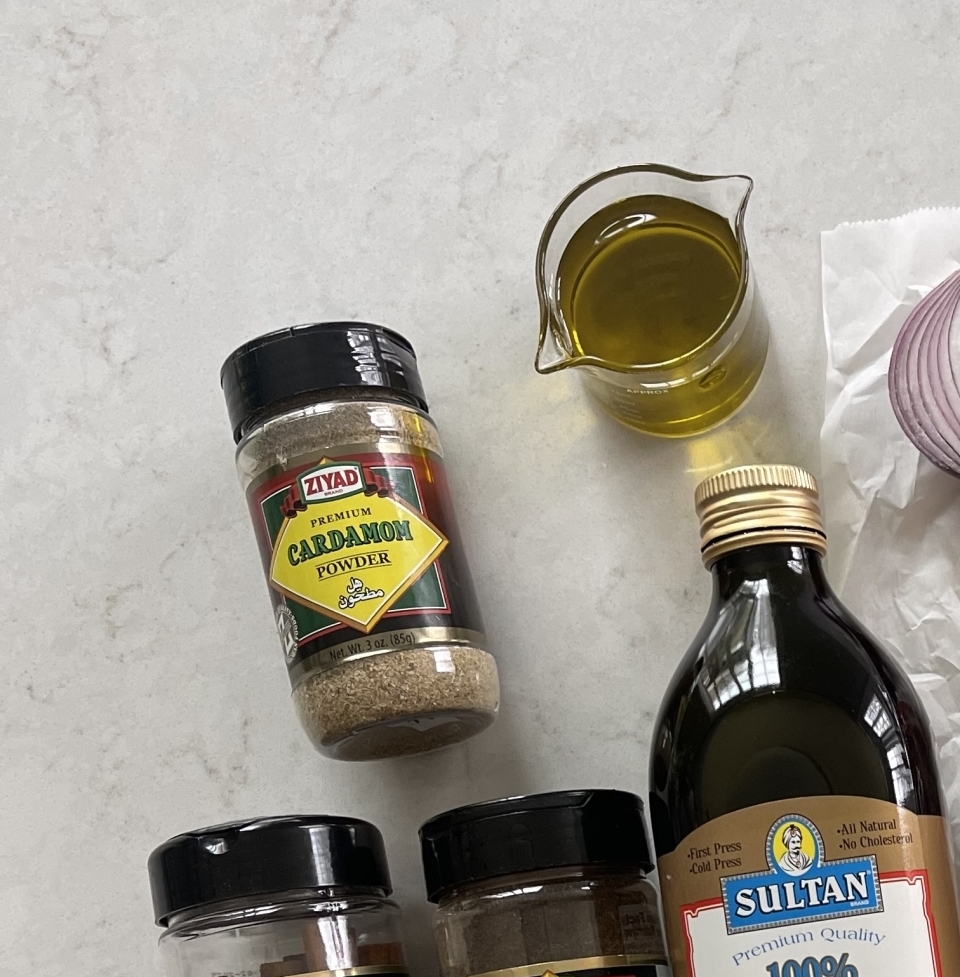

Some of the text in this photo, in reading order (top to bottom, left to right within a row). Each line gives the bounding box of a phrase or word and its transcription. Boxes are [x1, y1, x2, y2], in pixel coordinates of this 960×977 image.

[304, 469, 359, 496] ZIYAD
[310, 507, 372, 528] PREMIUM
[288, 520, 414, 566] CARDAMOM
[316, 552, 391, 578] POWDER
[338, 588, 385, 609] مطحون
[368, 640, 372, 650] 3
[375, 638, 388, 648] oz.
[390, 632, 416, 648] (85g)
[841, 819, 897, 836] All Natural
[714, 841, 742, 856] Press
[844, 833, 914, 850] No Cholesterol
[692, 857, 742, 874] Cold Press
[735, 871, 869, 918] SULTAN
[850, 900, 870, 908] BRAND
[732, 928, 886, 966] Premium Quality
